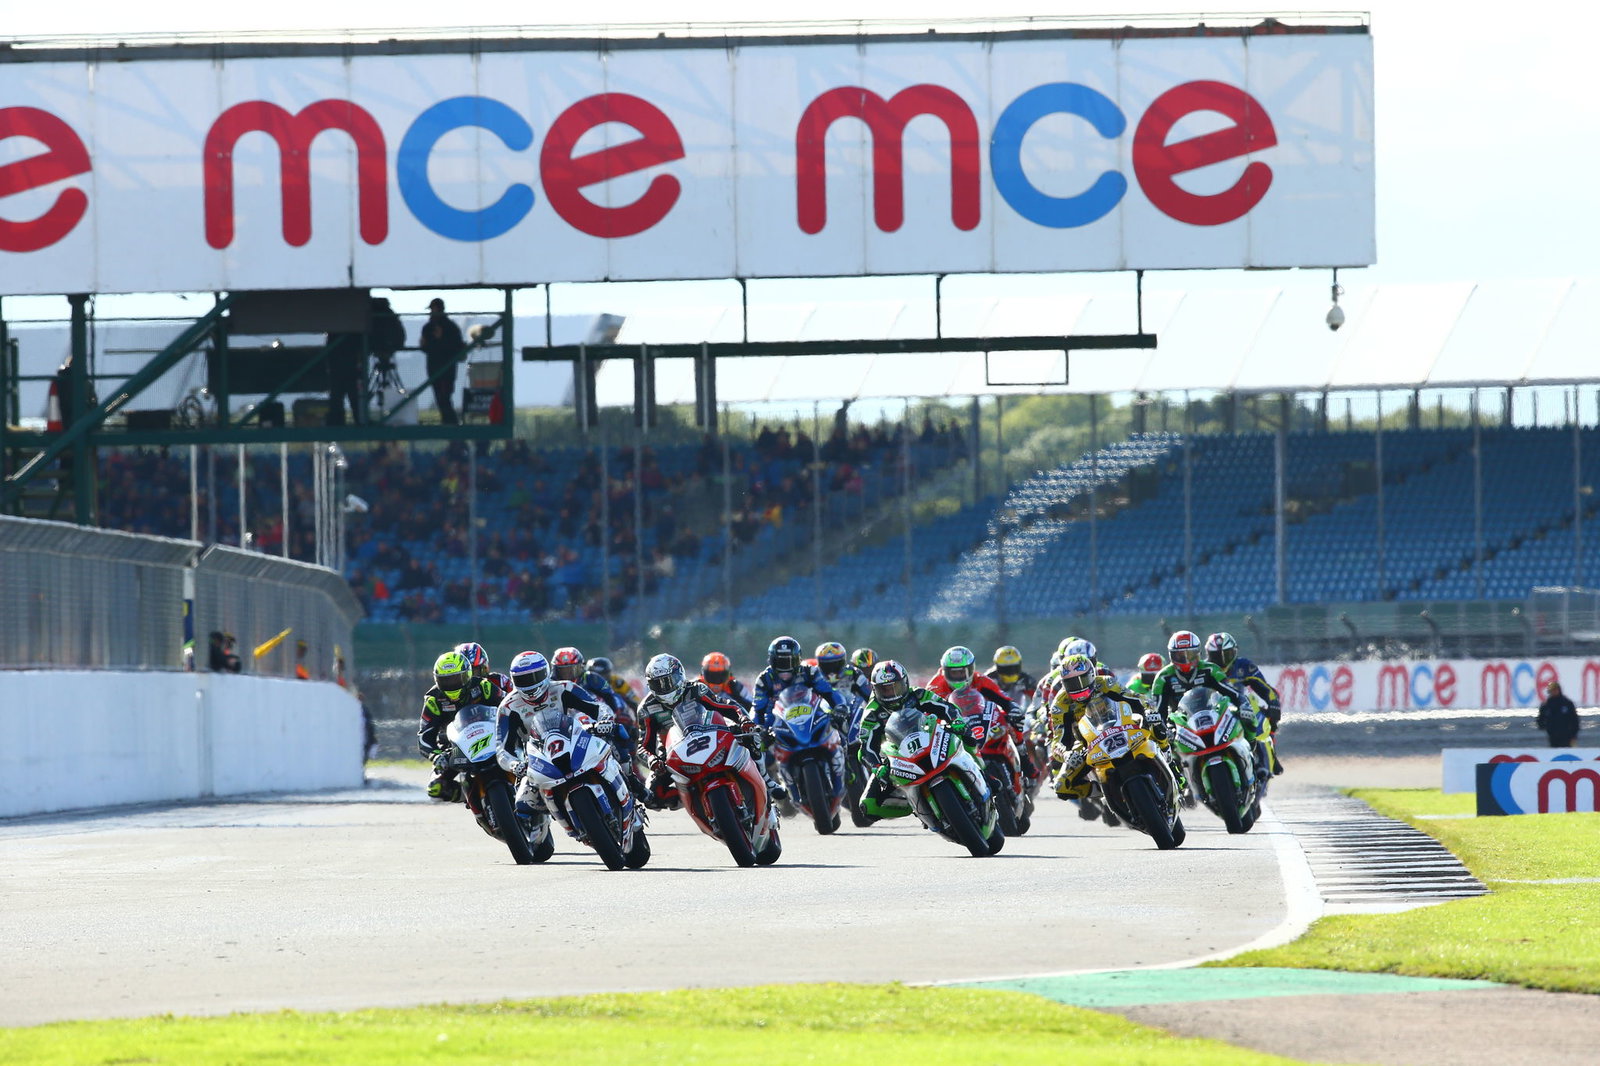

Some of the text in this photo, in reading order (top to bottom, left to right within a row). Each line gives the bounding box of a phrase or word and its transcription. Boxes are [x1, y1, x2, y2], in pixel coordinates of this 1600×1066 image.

[203, 92, 686, 250] mce
[796, 79, 1278, 235] mce
[1277, 664, 1354, 711] mce
[1377, 662, 1457, 709] mce
[1480, 661, 1558, 707] mce
[468, 732, 494, 759] 77
[686, 736, 711, 757] 22
[907, 738, 922, 754] 91
[1103, 732, 1129, 754] 25
[895, 770, 917, 780] OXFORD
